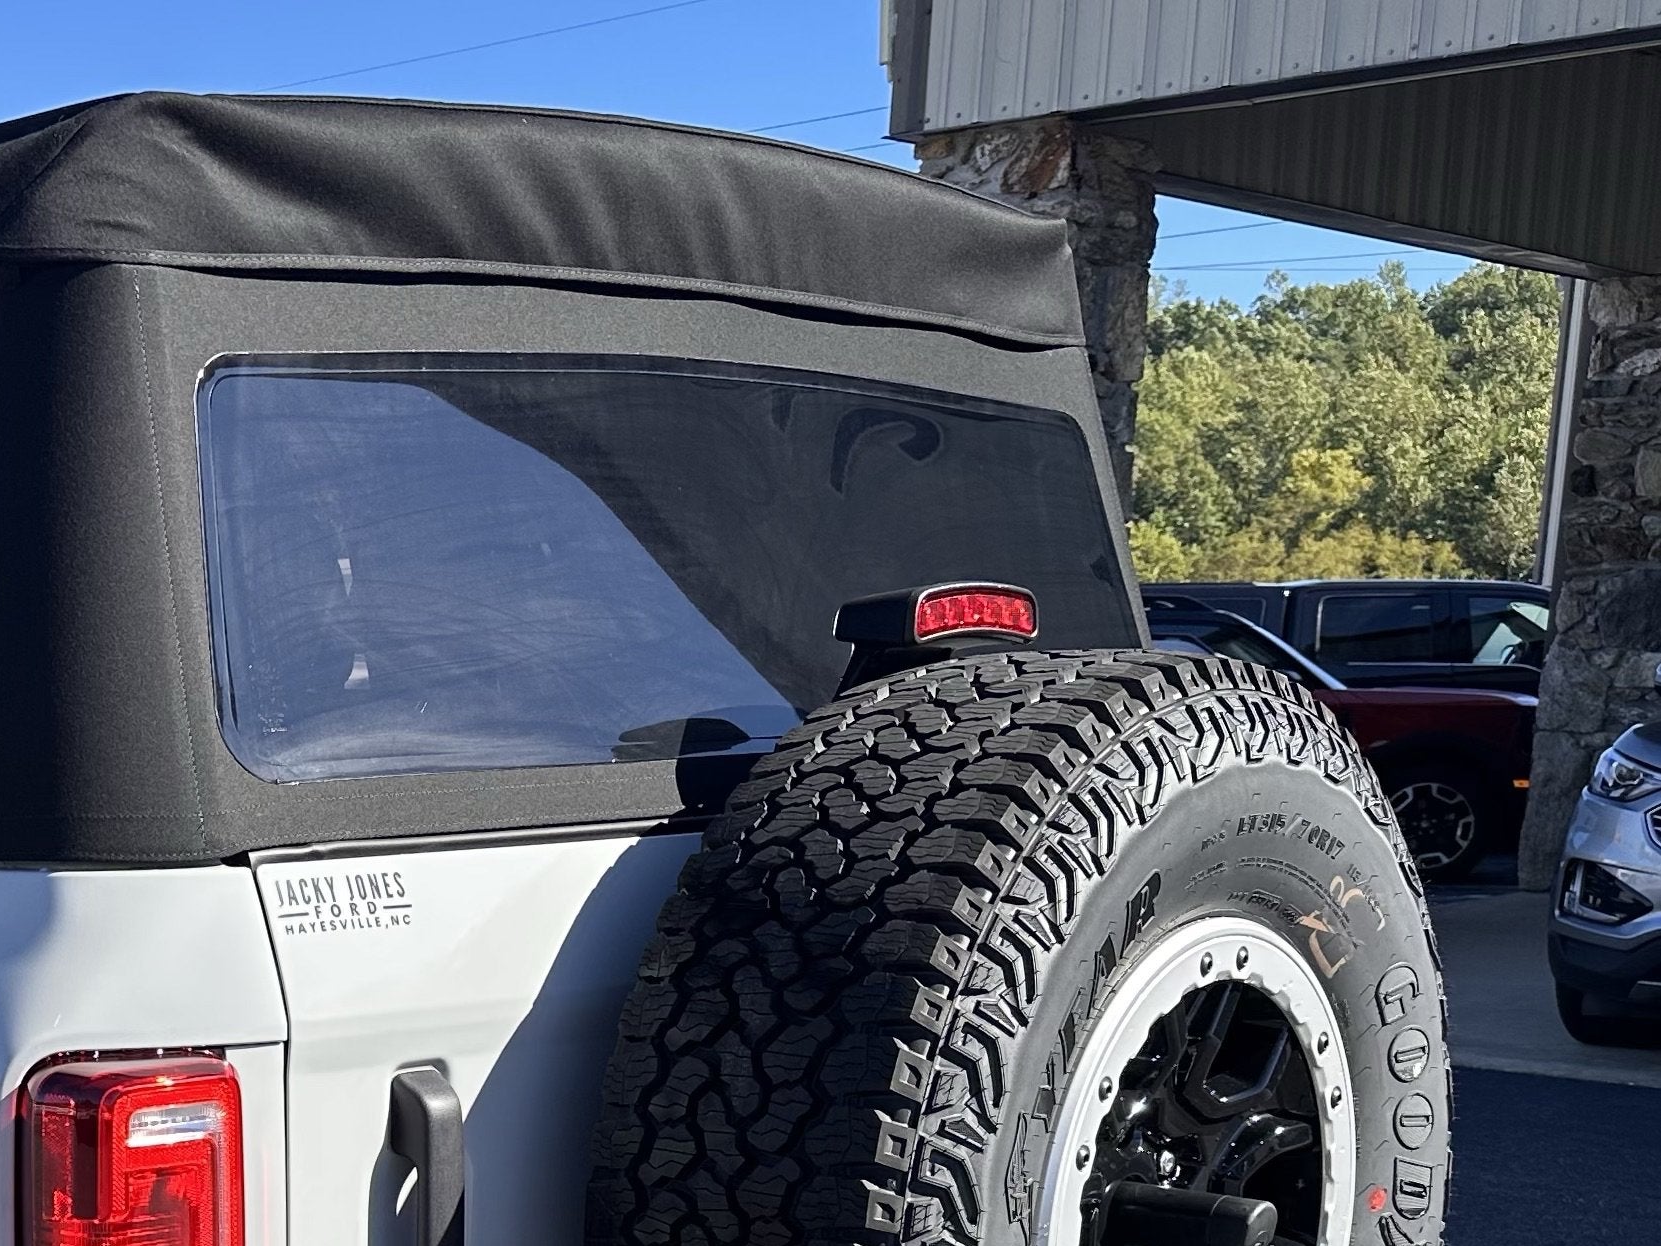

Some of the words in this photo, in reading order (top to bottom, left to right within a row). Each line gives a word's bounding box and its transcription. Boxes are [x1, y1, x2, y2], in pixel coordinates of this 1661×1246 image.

[274, 875, 338, 908] JACKY
[345, 871, 407, 901] JONES
[313, 900, 378, 920] FORD
